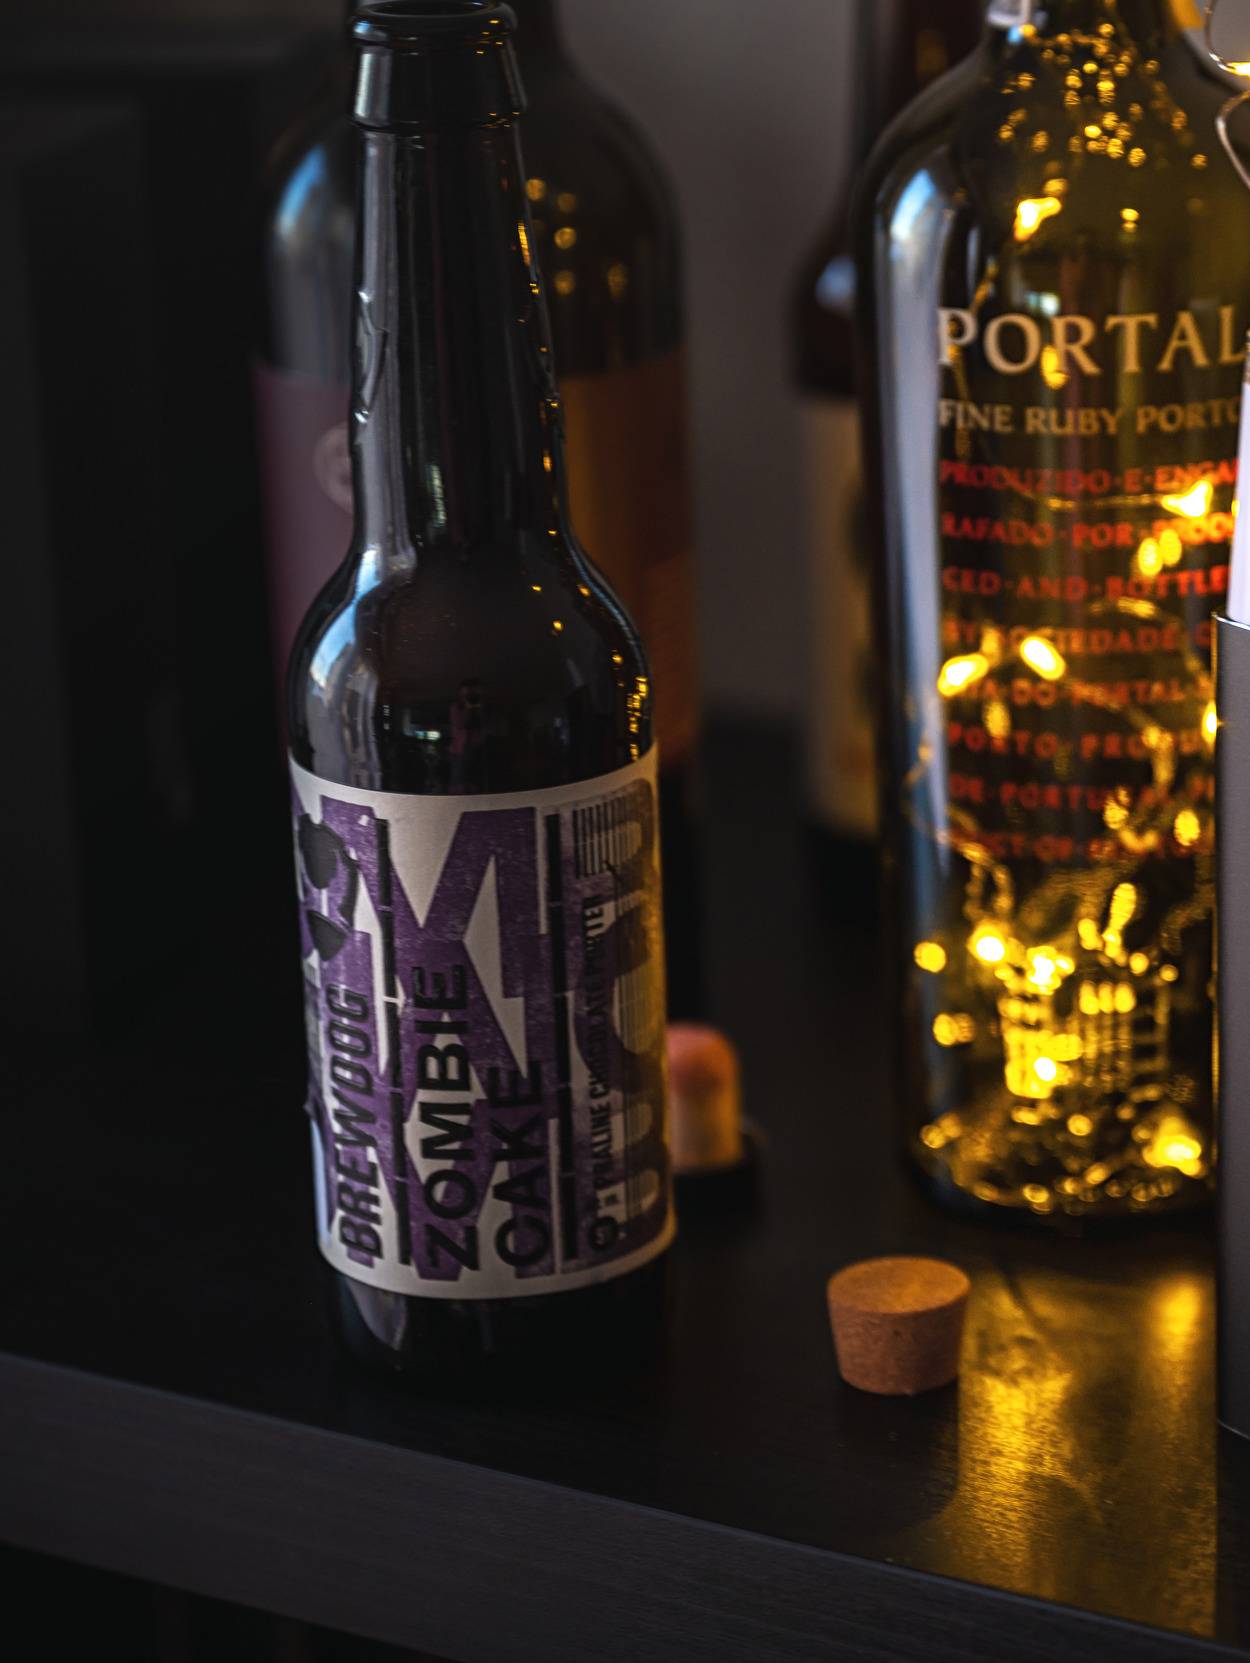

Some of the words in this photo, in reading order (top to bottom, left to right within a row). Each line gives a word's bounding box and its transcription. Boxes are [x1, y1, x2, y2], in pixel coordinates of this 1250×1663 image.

[938, 305, 1246, 376] PORTAL
[939, 398, 1014, 433] FINE
[1024, 403, 1122, 436] RUBY
[1154, 459, 1238, 492] ENGA
[1072, 522, 1132, 548] POR
[942, 565, 1003, 596] CED
[1016, 576, 1088, 602] AND
[1106, 564, 1231, 600] BOTTLE
[324, 983, 384, 1260] BREWDOG
[410, 963, 480, 1272] ZOMBIE
[487, 1062, 552, 1269] CAKE
